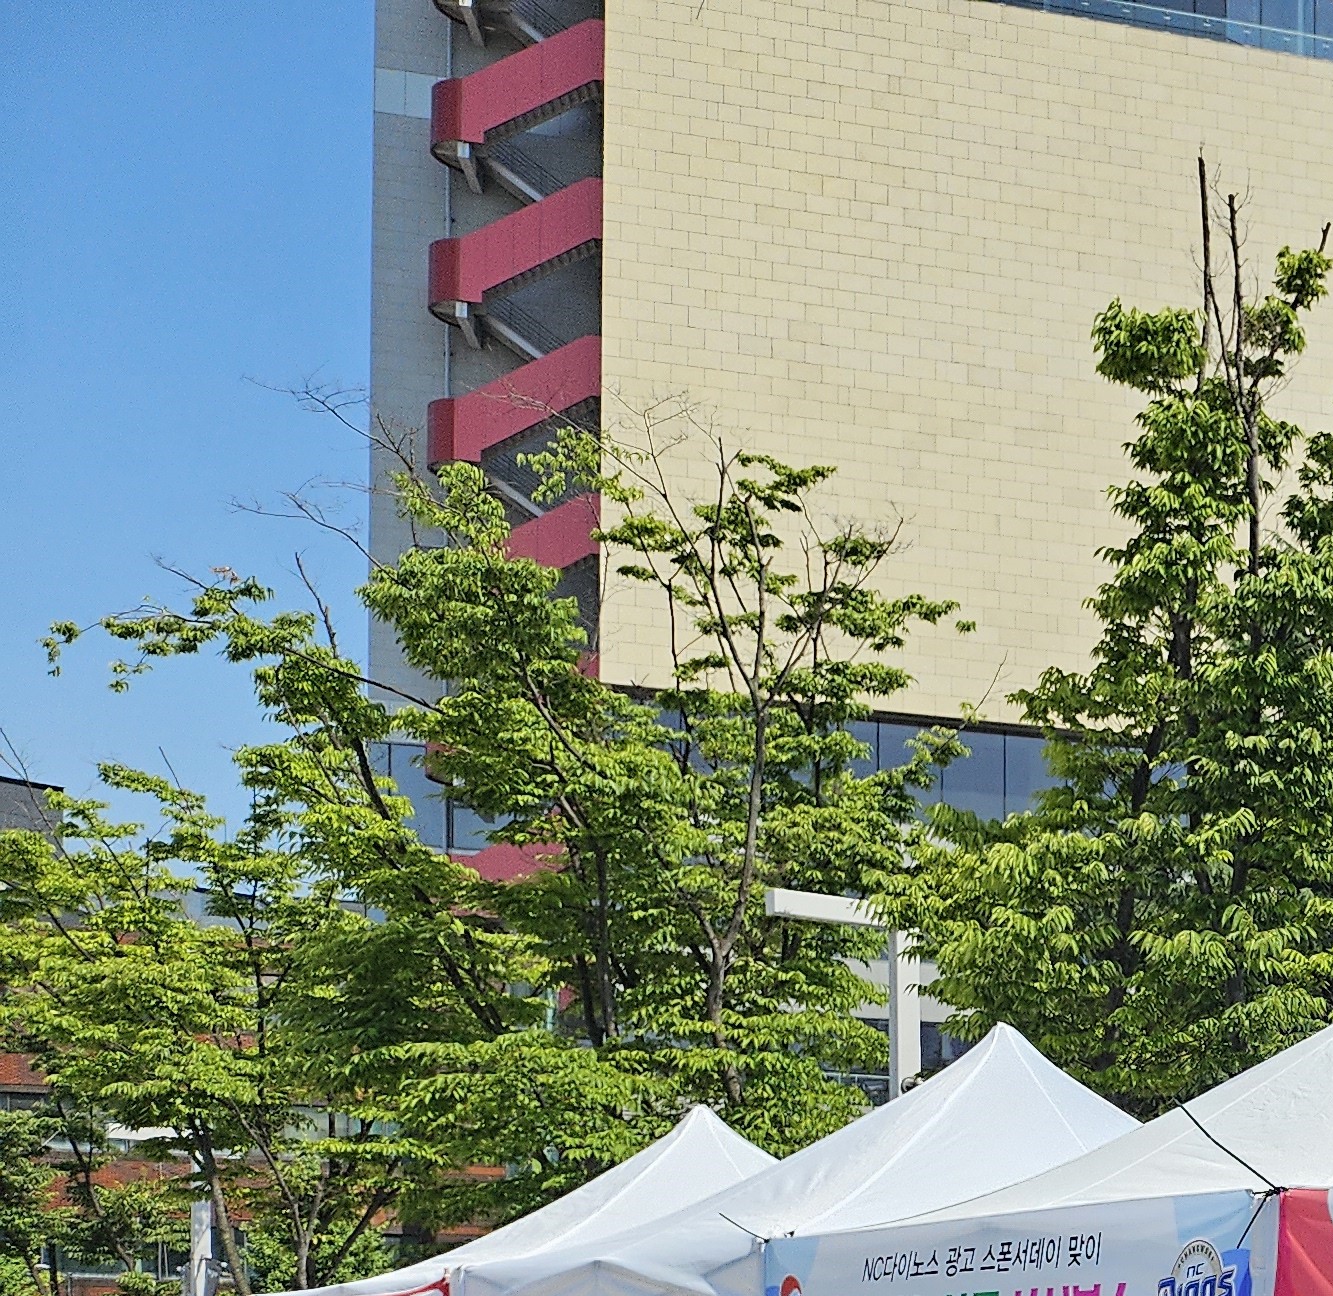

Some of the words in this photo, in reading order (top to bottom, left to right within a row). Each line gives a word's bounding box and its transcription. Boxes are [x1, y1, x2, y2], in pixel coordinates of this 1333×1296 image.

[862, 1249, 939, 1282] NC다이노스
[946, 1246, 976, 1278] 광고
[980, 1235, 1062, 1273] 스폰서데이
[1067, 1231, 1102, 1268] 맞이
